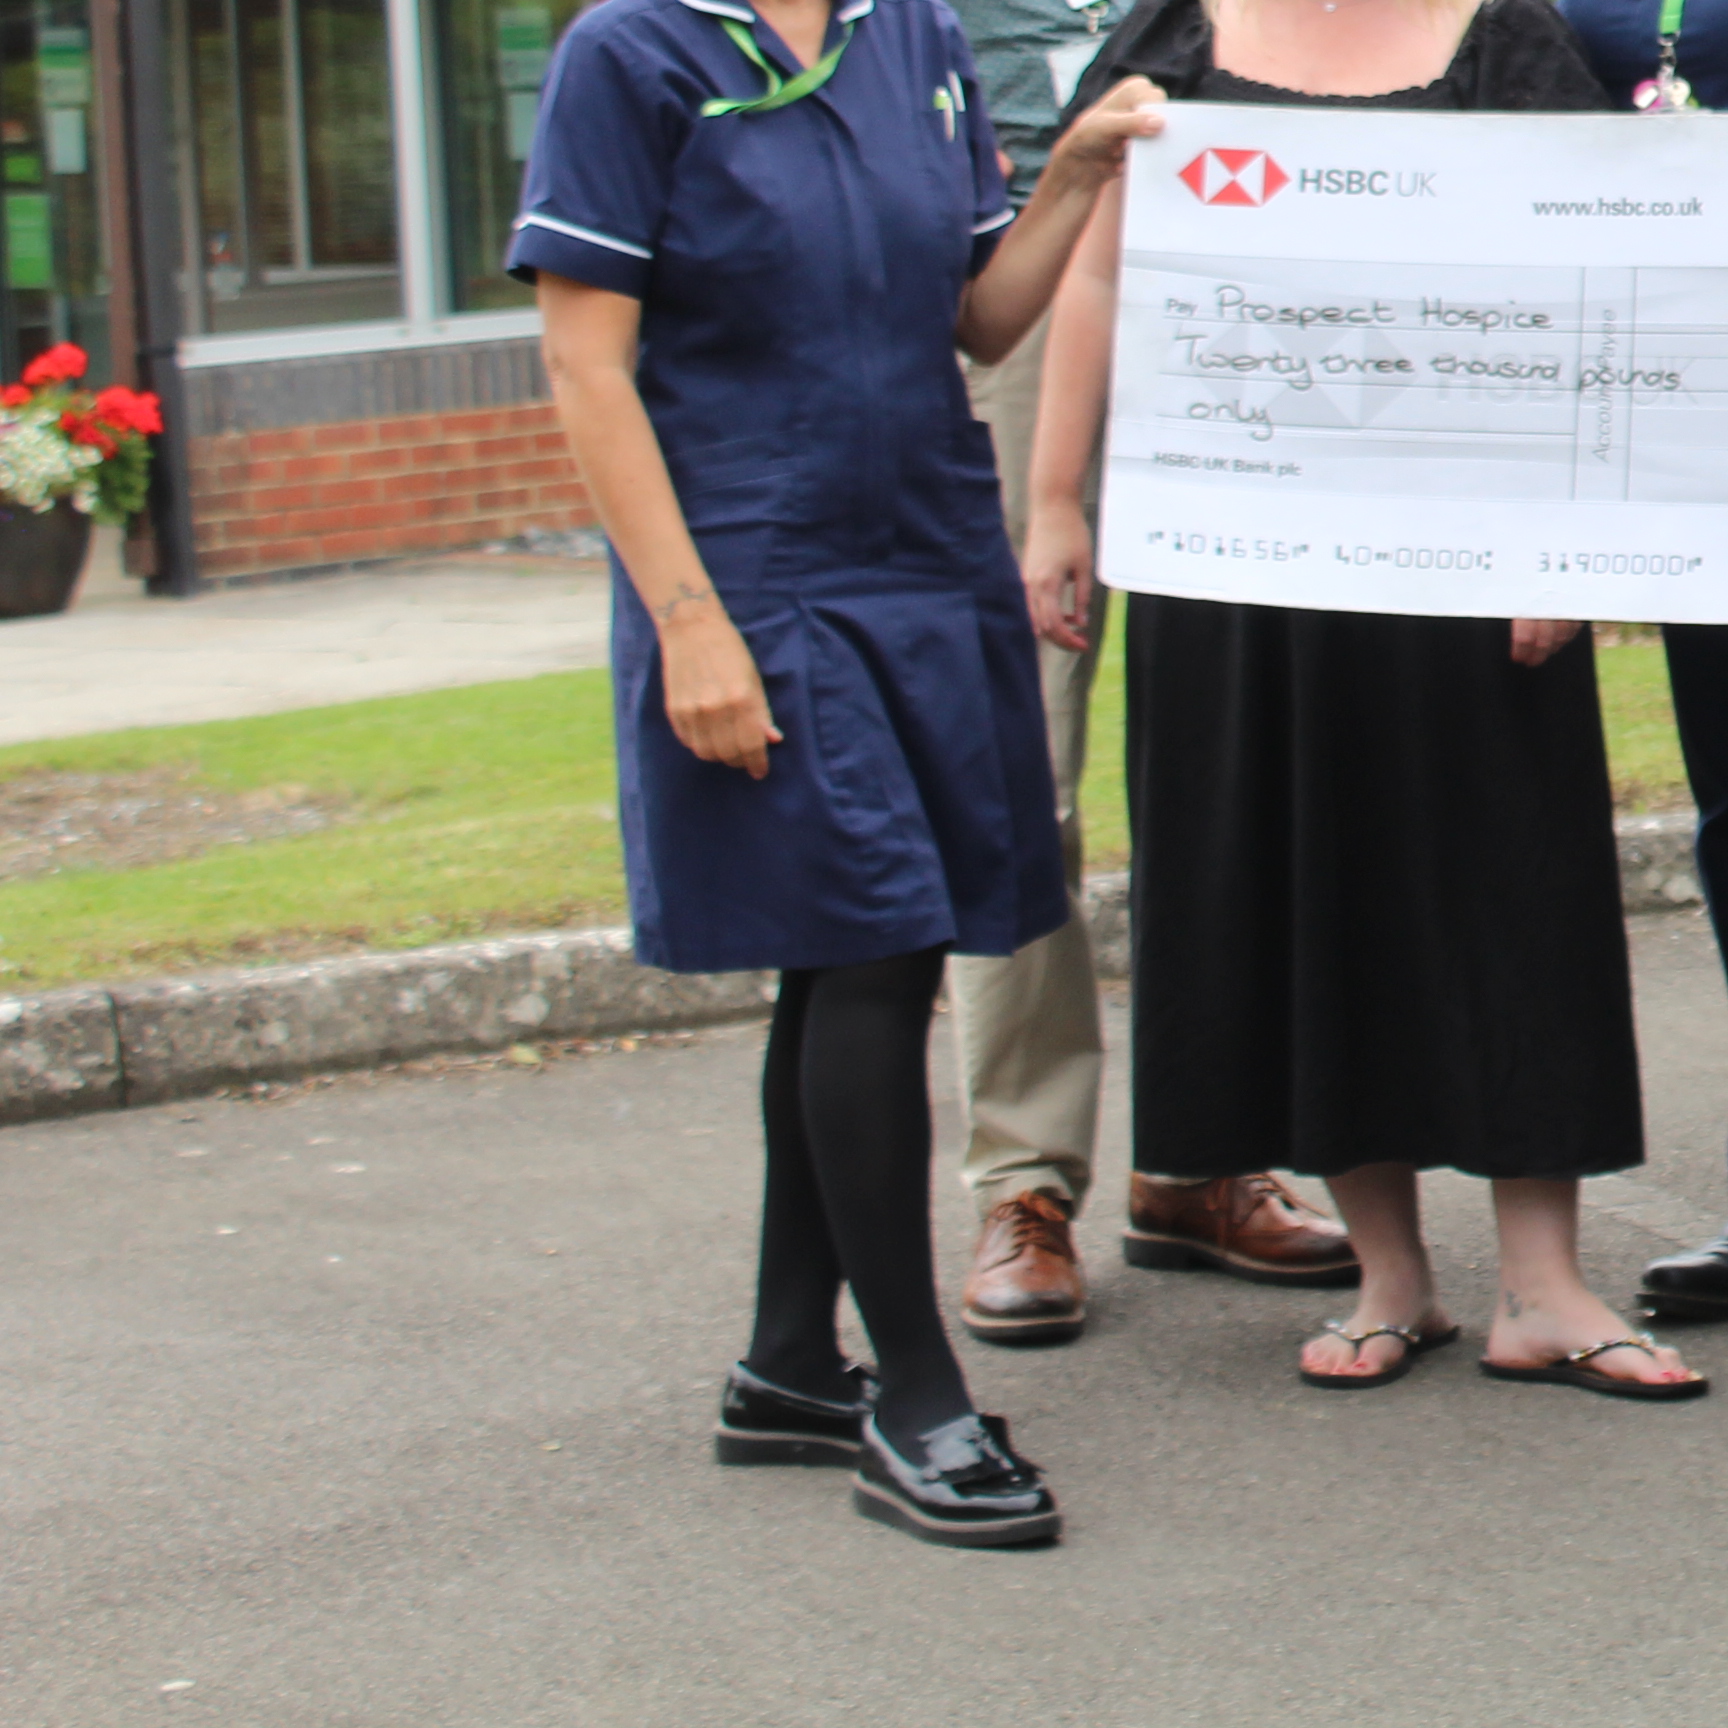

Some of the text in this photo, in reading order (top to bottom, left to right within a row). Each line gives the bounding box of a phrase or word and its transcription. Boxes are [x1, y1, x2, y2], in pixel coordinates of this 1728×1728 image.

[1299, 168, 1437, 198] HSBC UK
[1533, 197, 1703, 218] www.hsbc.co.uk
[1166, 285, 1555, 334] Pay Prospect Hospice
[1175, 325, 1314, 391] Twenty
[1319, 353, 1416, 375] three
[1578, 367, 1682, 392] pounds
[1187, 399, 1275, 442] only
[1153, 452, 1303, 478] HSBC UK Bank plc
